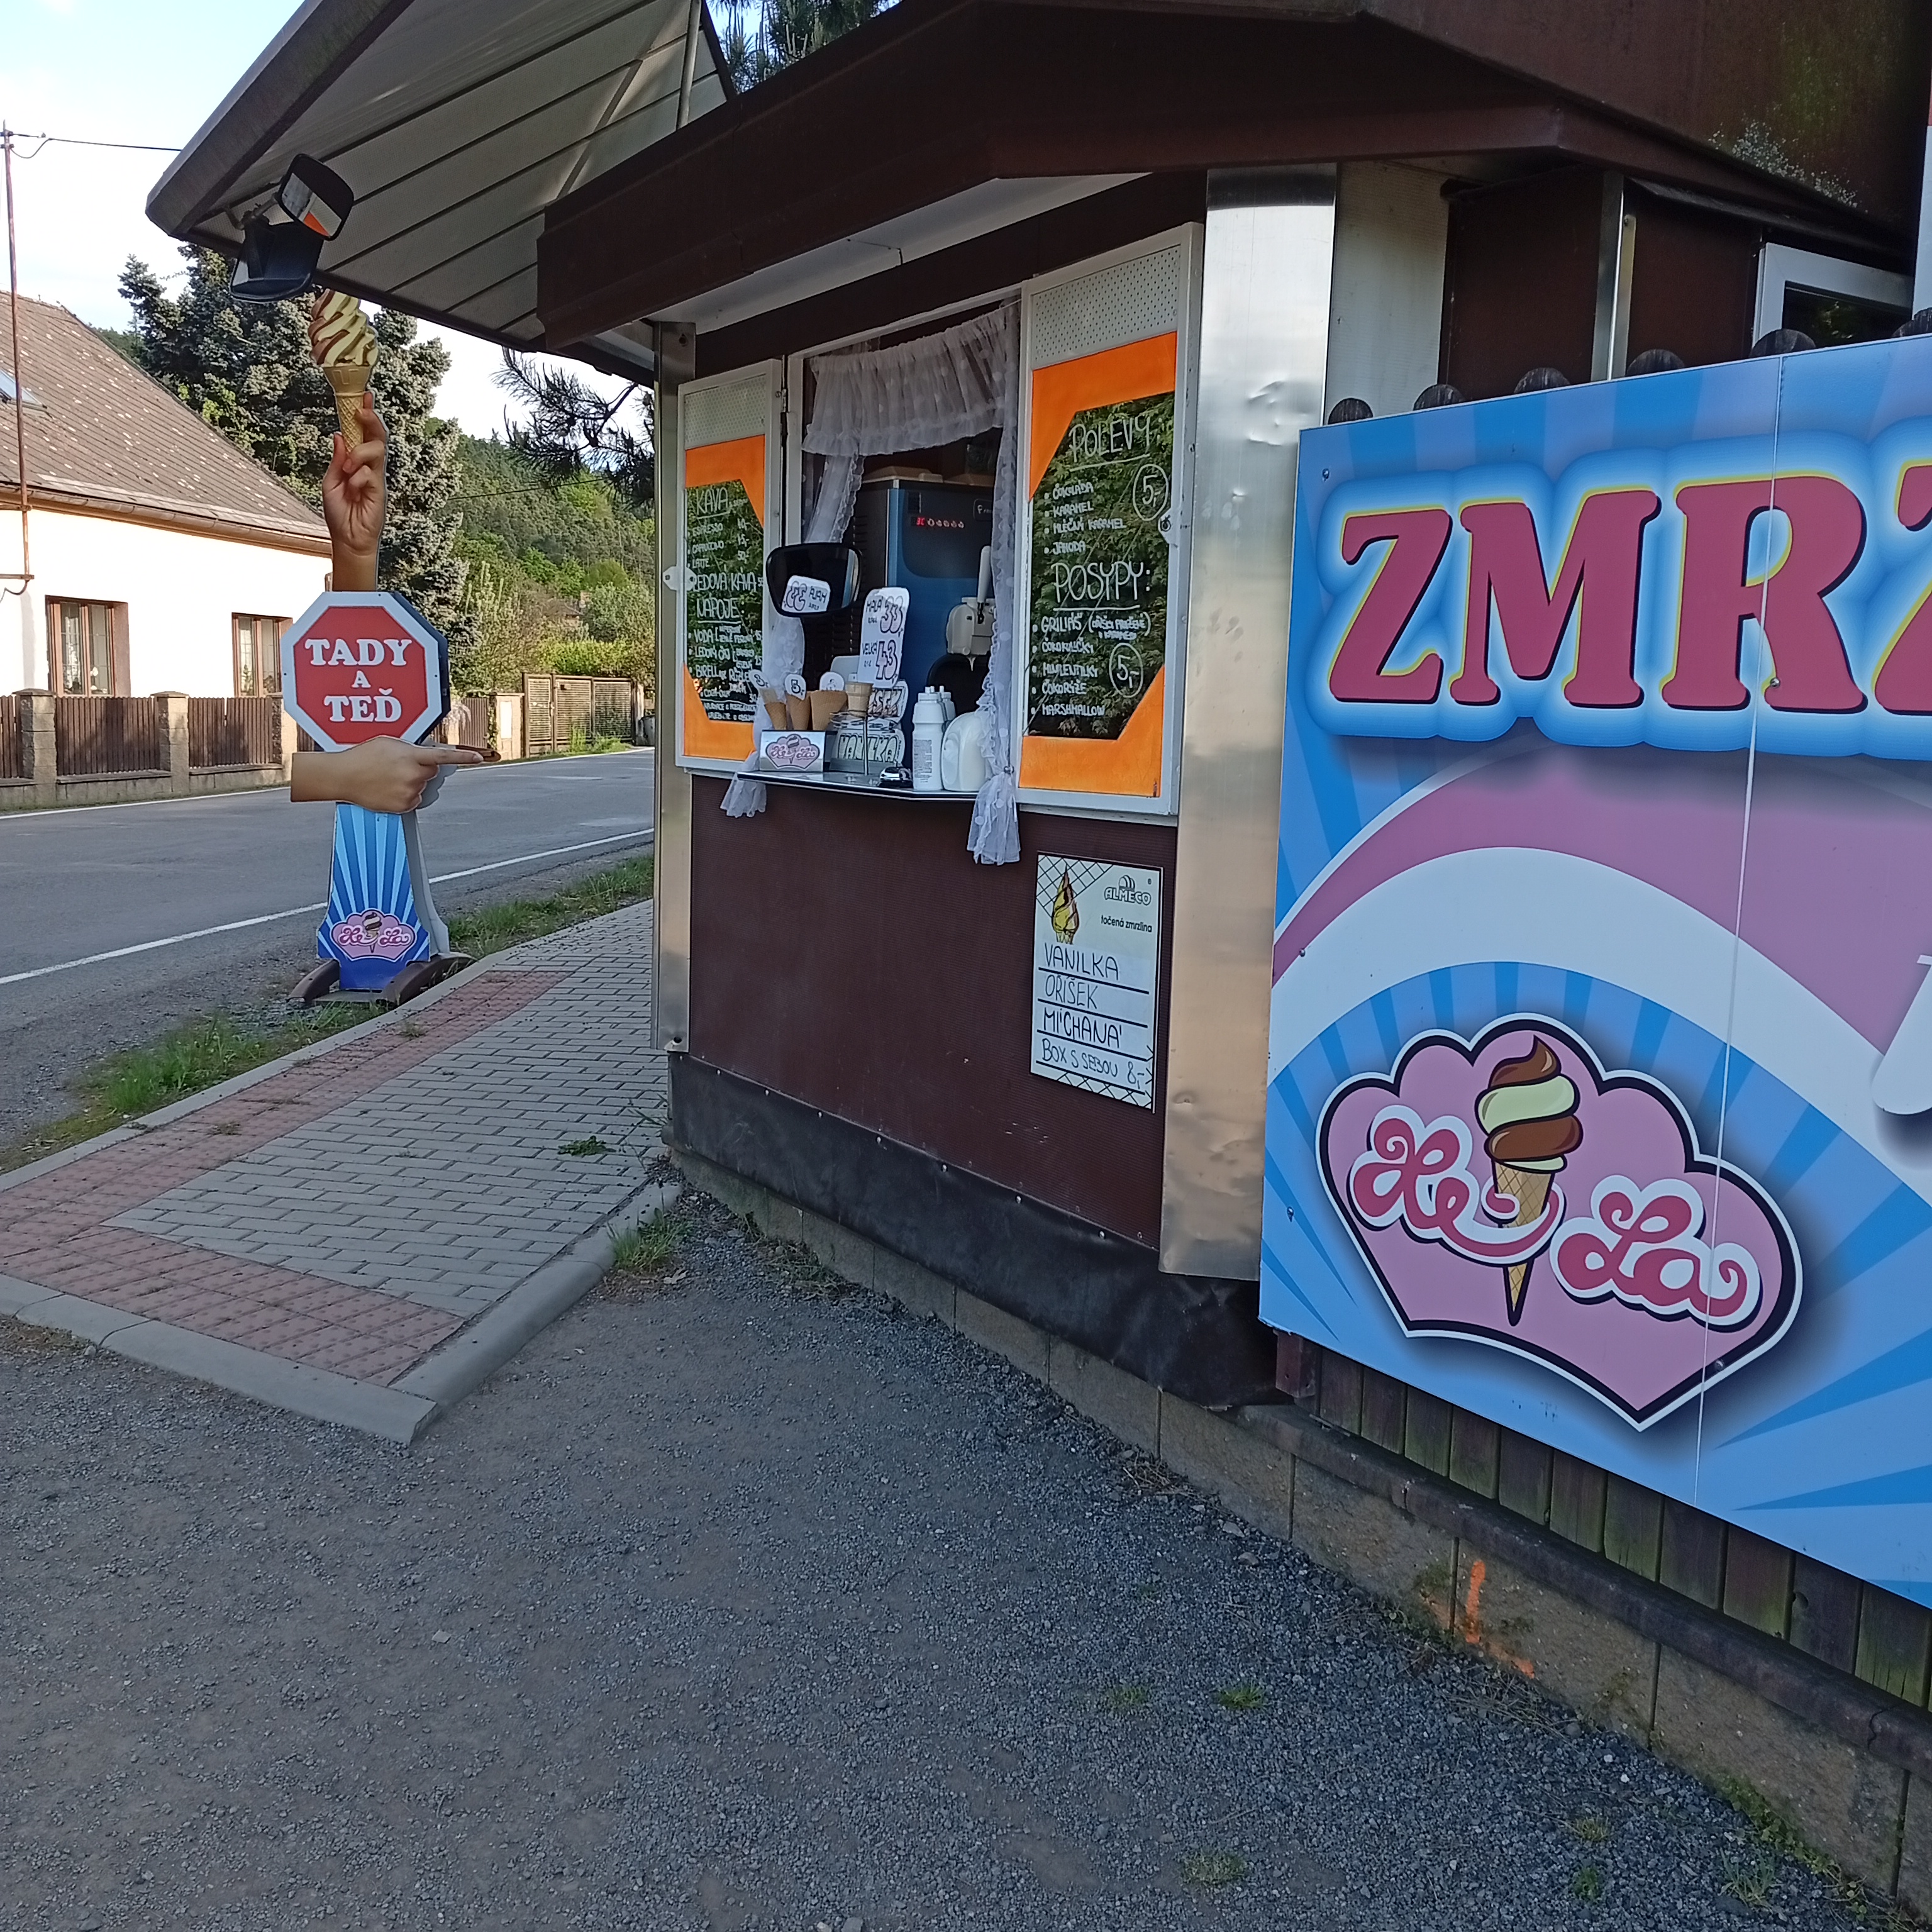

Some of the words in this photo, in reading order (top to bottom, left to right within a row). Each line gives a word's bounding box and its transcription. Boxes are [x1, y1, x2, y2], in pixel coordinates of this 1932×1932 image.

[1053, 541, 1086, 555] JAHODA
[304, 638, 413, 667] TADY
[351, 670, 372, 689] A
[323, 687, 402, 723] TEĎ
[1042, 703, 1105, 716] MARSHMALLOW
[1104, 886, 1152, 906] ALMECO
[1101, 914, 1124, 928] točená
[1125, 921, 1152, 933] zmrzlina
[1044, 942, 1119, 980] VANILKA
[1045, 974, 1098, 1009] OŘÍŠEK
[1043, 1007, 1122, 1048] MÍCHANÁ
[1042, 1038, 1067, 1063] BOX
[1070, 1050, 1079, 1069] S
[1081, 1052, 1118, 1077] SEBOU
[1127, 1061, 1145, 1089] 8,-
